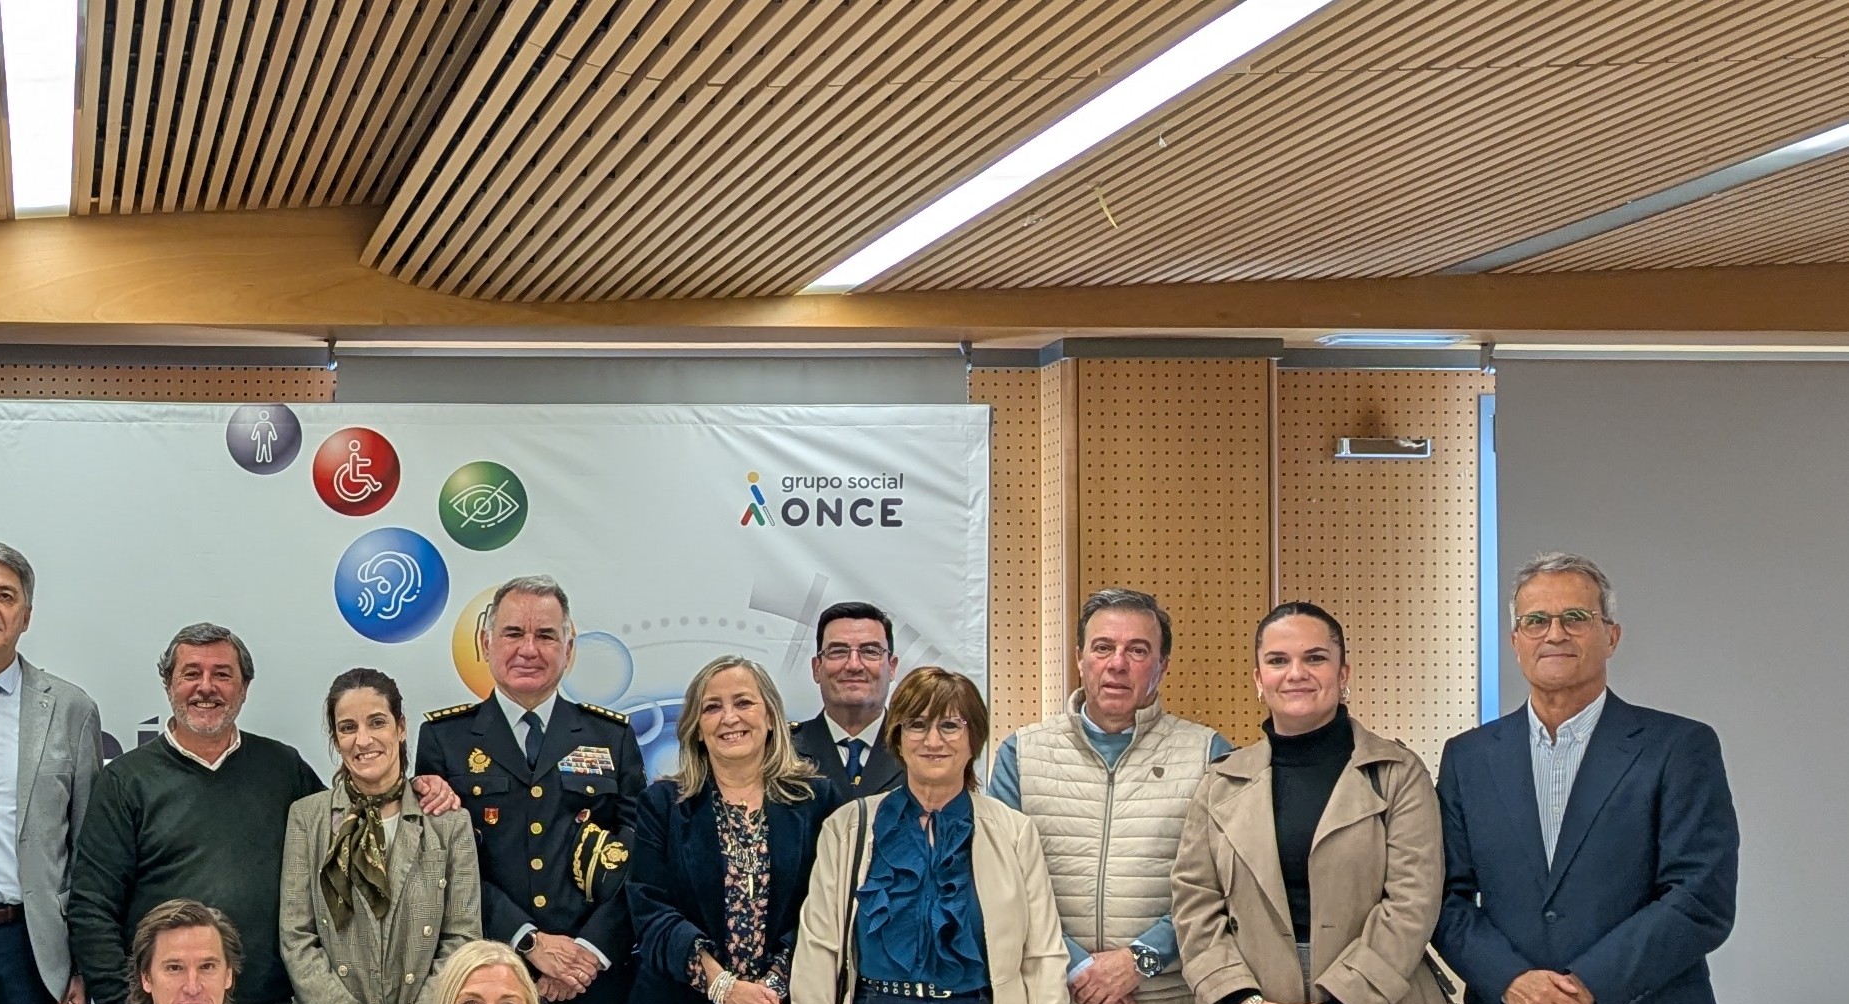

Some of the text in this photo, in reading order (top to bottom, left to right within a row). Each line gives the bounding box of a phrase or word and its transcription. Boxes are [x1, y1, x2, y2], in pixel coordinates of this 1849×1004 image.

[781, 472, 904, 493] grupo social
[781, 497, 904, 528] ONCE
